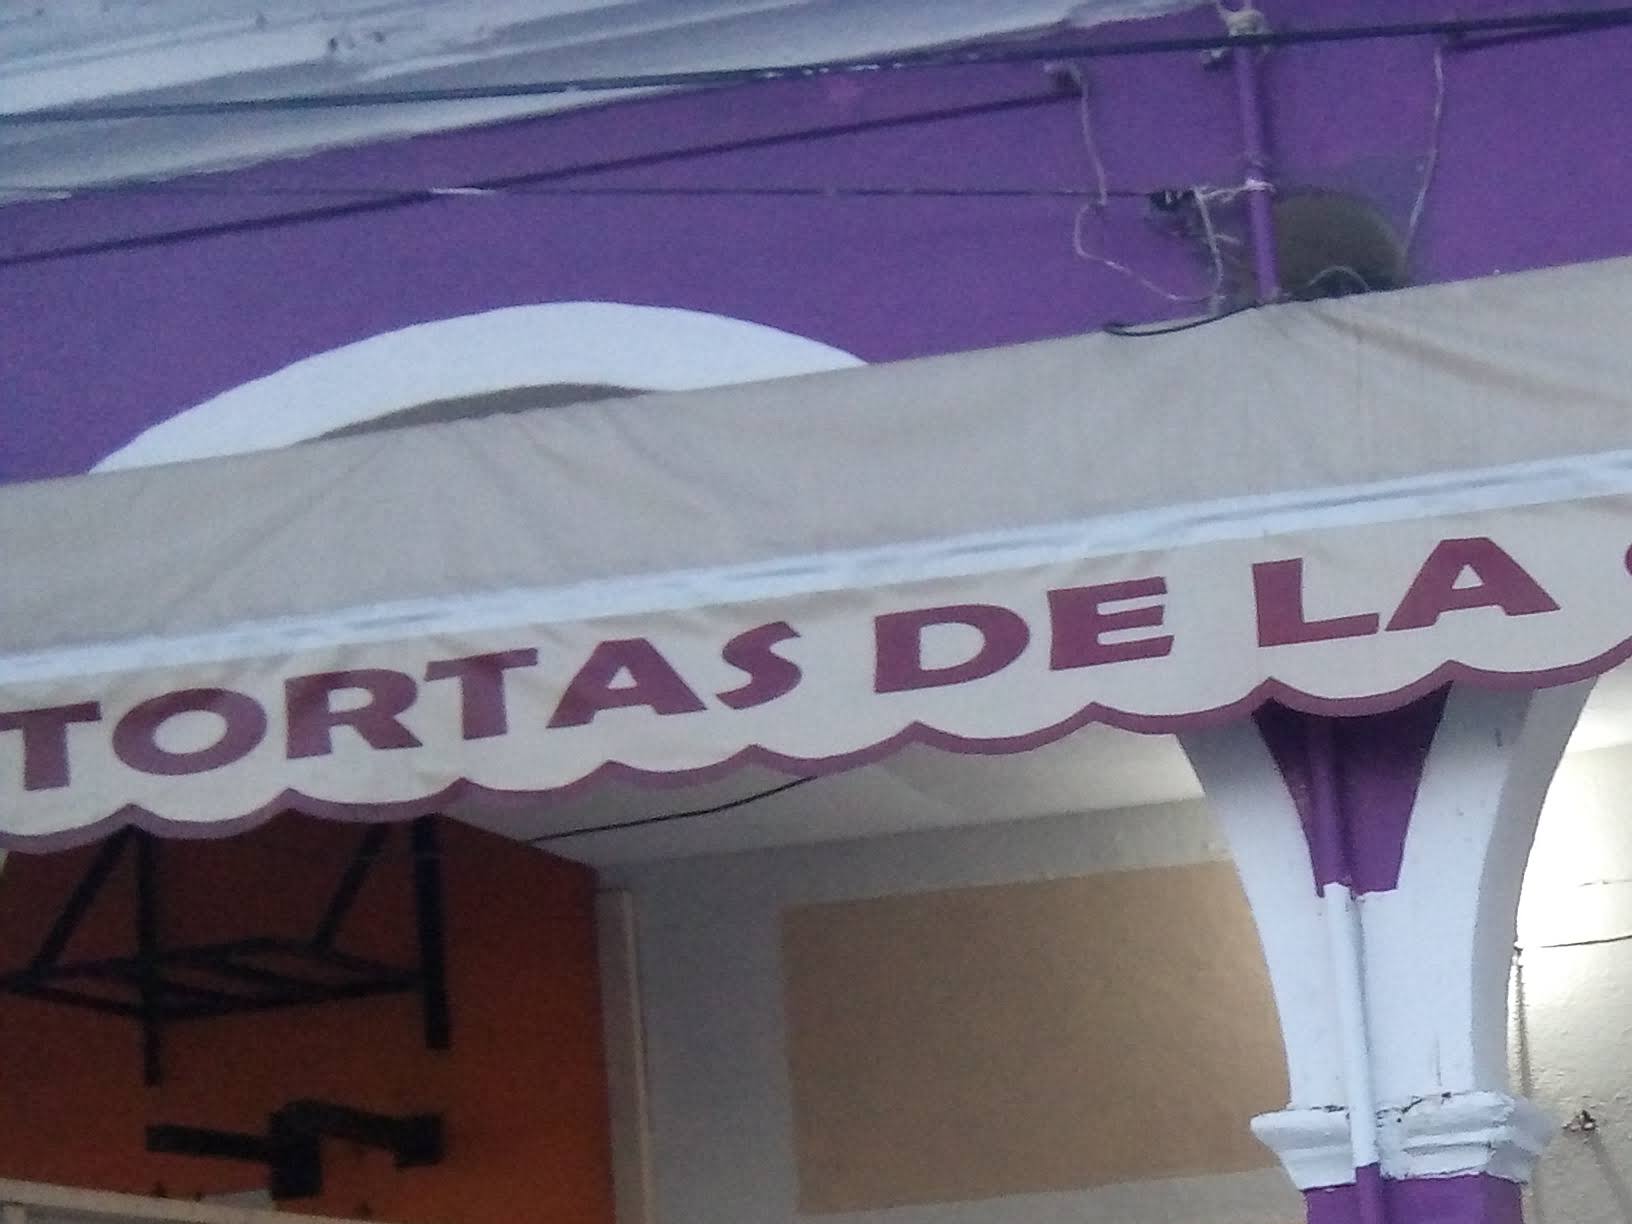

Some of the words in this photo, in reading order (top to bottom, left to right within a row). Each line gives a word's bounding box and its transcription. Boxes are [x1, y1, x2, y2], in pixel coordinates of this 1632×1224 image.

[0, 620, 804, 791] TORTAS
[874, 575, 1174, 694] DE
[1252, 536, 1560, 648] LA
